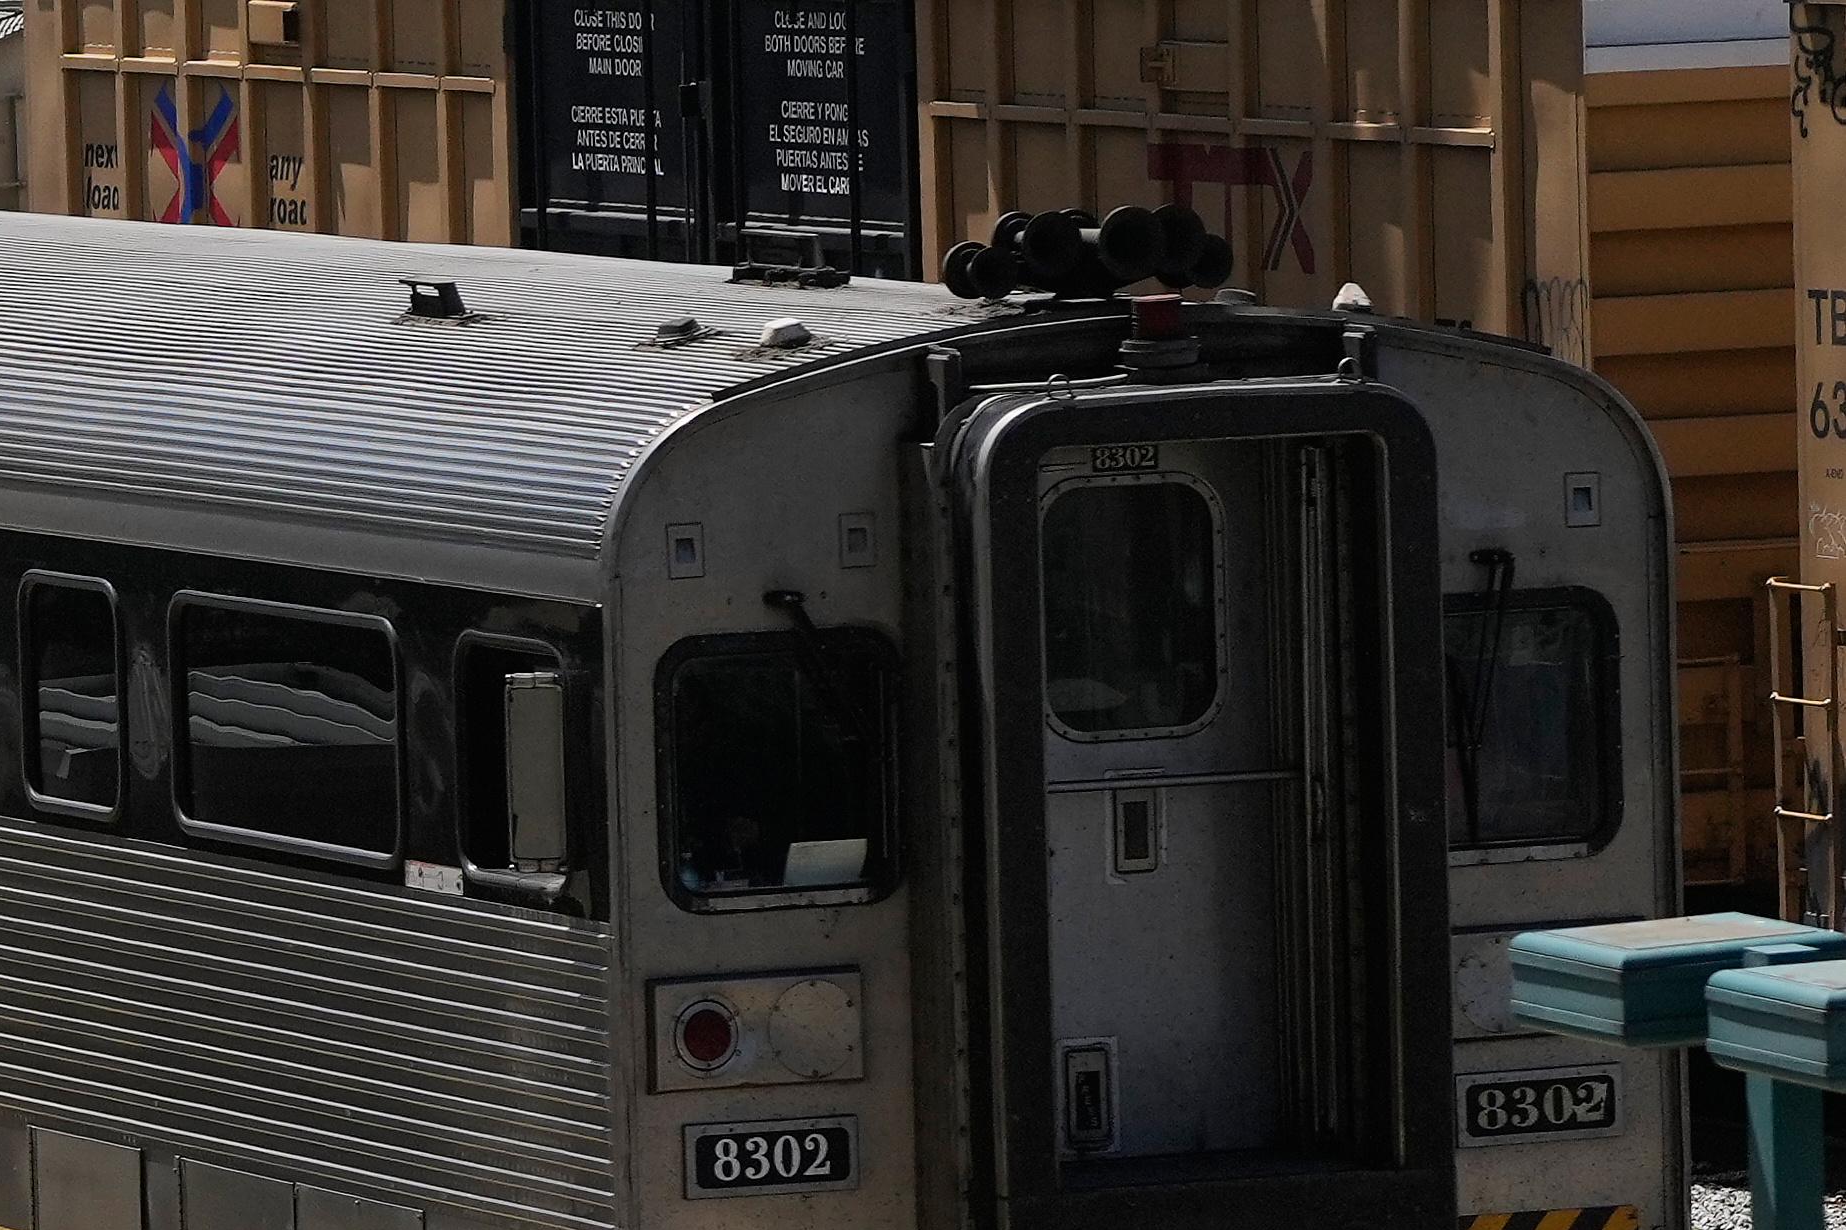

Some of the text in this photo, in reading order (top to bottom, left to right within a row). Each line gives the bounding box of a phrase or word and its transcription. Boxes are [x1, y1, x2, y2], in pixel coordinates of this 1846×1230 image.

[605, 11, 627, 28] THIS
[807, 12, 826, 29] AND
[576, 33, 643, 53] BEFORE CLOSI
[765, 35, 865, 55] BOTH DOORS BEFRE
[588, 57, 642, 76] MAIN DOOR
[787, 59, 844, 78] MOVING CAR
[571, 106, 662, 128] CIERRE ESTA PUEA
[781, 100, 848, 122] CIERRE Y PONG
[577, 130, 607, 148] ANTES
[609, 132, 621, 148] DE
[769, 124, 781, 141] EL
[783, 125, 821, 144] SEGURO
[822, 127, 835, 145] EN
[572, 153, 665, 176] LA PUERTA PRINCL
[776, 149, 818, 169] PUERTAS
[819, 151, 849, 170] ANTES
[269, 153, 303, 191] any
[781, 173, 815, 191] MOVER
[816, 175, 827, 193] EL
[1095, 446, 1155, 469] 8302
[1477, 1081, 1608, 1130] 8302
[713, 1133, 831, 1182] 8302
